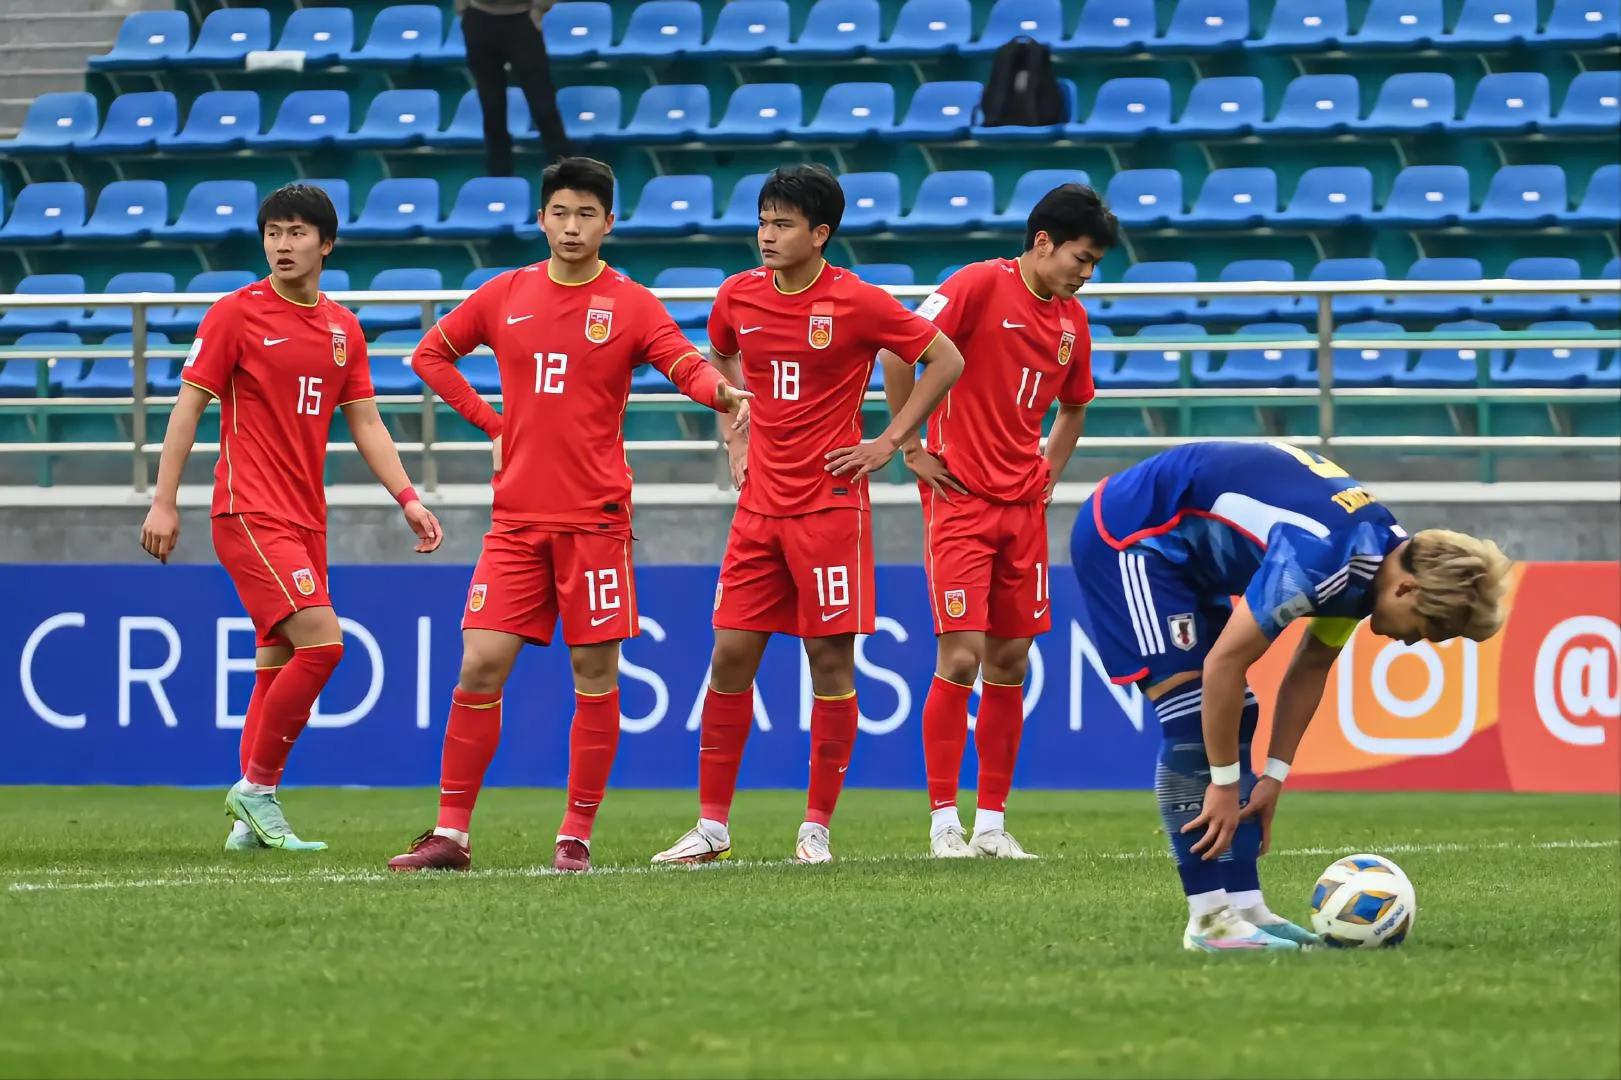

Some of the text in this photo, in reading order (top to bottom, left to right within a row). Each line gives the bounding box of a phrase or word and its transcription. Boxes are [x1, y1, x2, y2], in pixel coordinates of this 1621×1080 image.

[533, 352, 568, 394] 12
[770, 360, 800, 401] 18
[1016, 367, 1042, 408] 11
[297, 376, 323, 416] 15
[584, 568, 620, 611] 12
[812, 565, 850, 607] 18
[19, 612, 430, 729] CREDI
